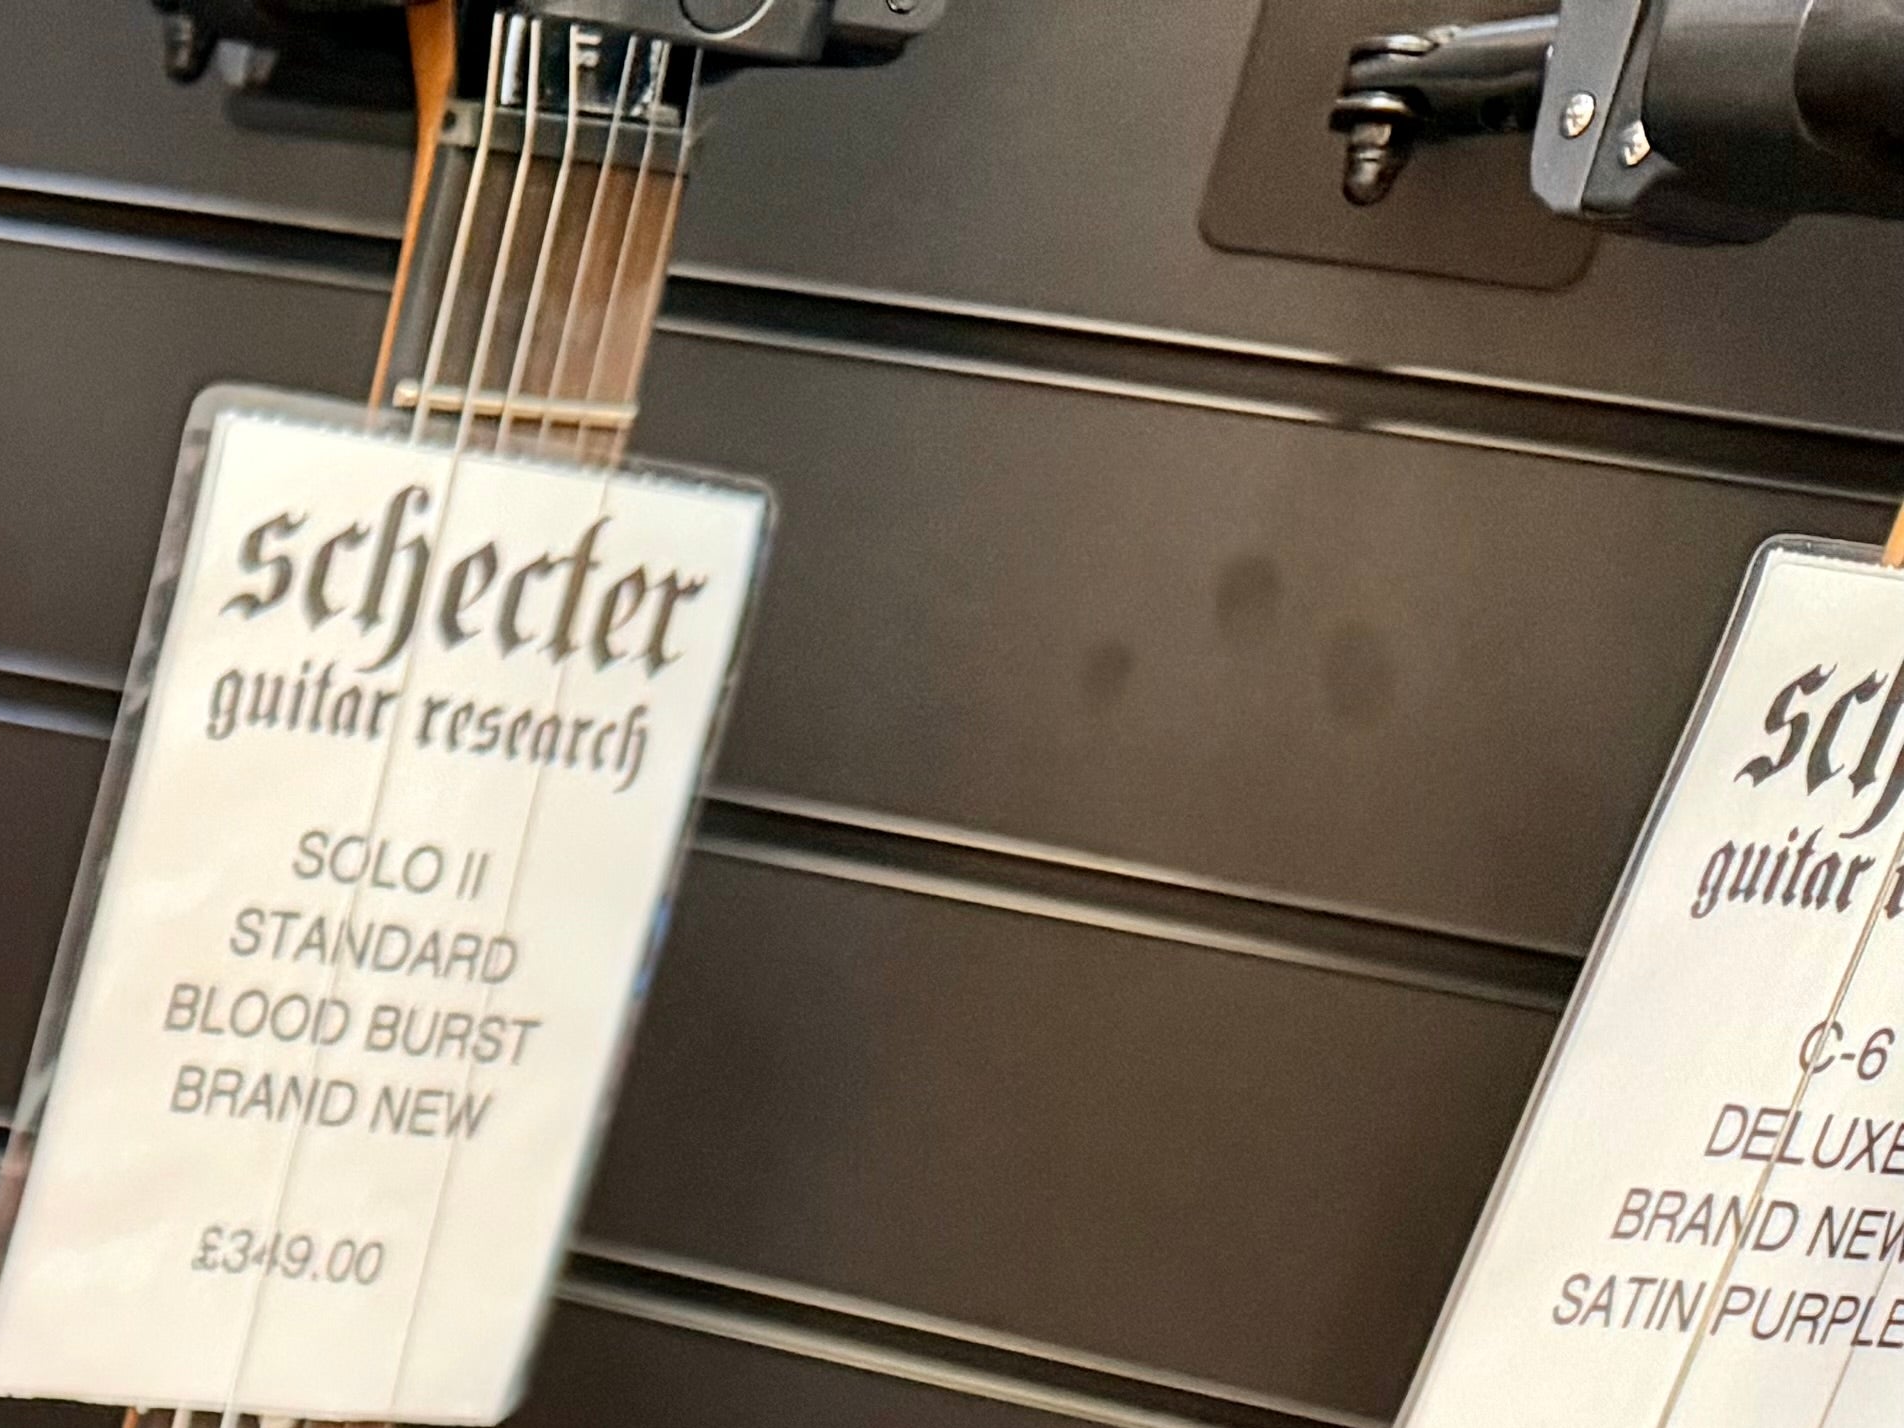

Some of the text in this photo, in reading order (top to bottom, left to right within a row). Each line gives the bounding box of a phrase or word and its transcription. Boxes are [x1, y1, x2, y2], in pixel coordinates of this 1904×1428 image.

[218, 482, 708, 682] schecter
[205, 661, 652, 793] guitar research
[292, 830, 446, 900] SOLO
[1690, 825, 1876, 920] guitar
[228, 907, 521, 989] STANDARD
[163, 982, 543, 1070] BLOOD BURST
[1799, 1020, 1896, 1082] C-6
[170, 1066, 496, 1142] BRAND NEW
[1704, 1103, 1904, 1176] DELUXE
[190, 1223, 390, 1288] £349.00
[1610, 1187, 1800, 1254] BRAND
[1551, 1270, 1904, 1349] SATIN PURPLE
